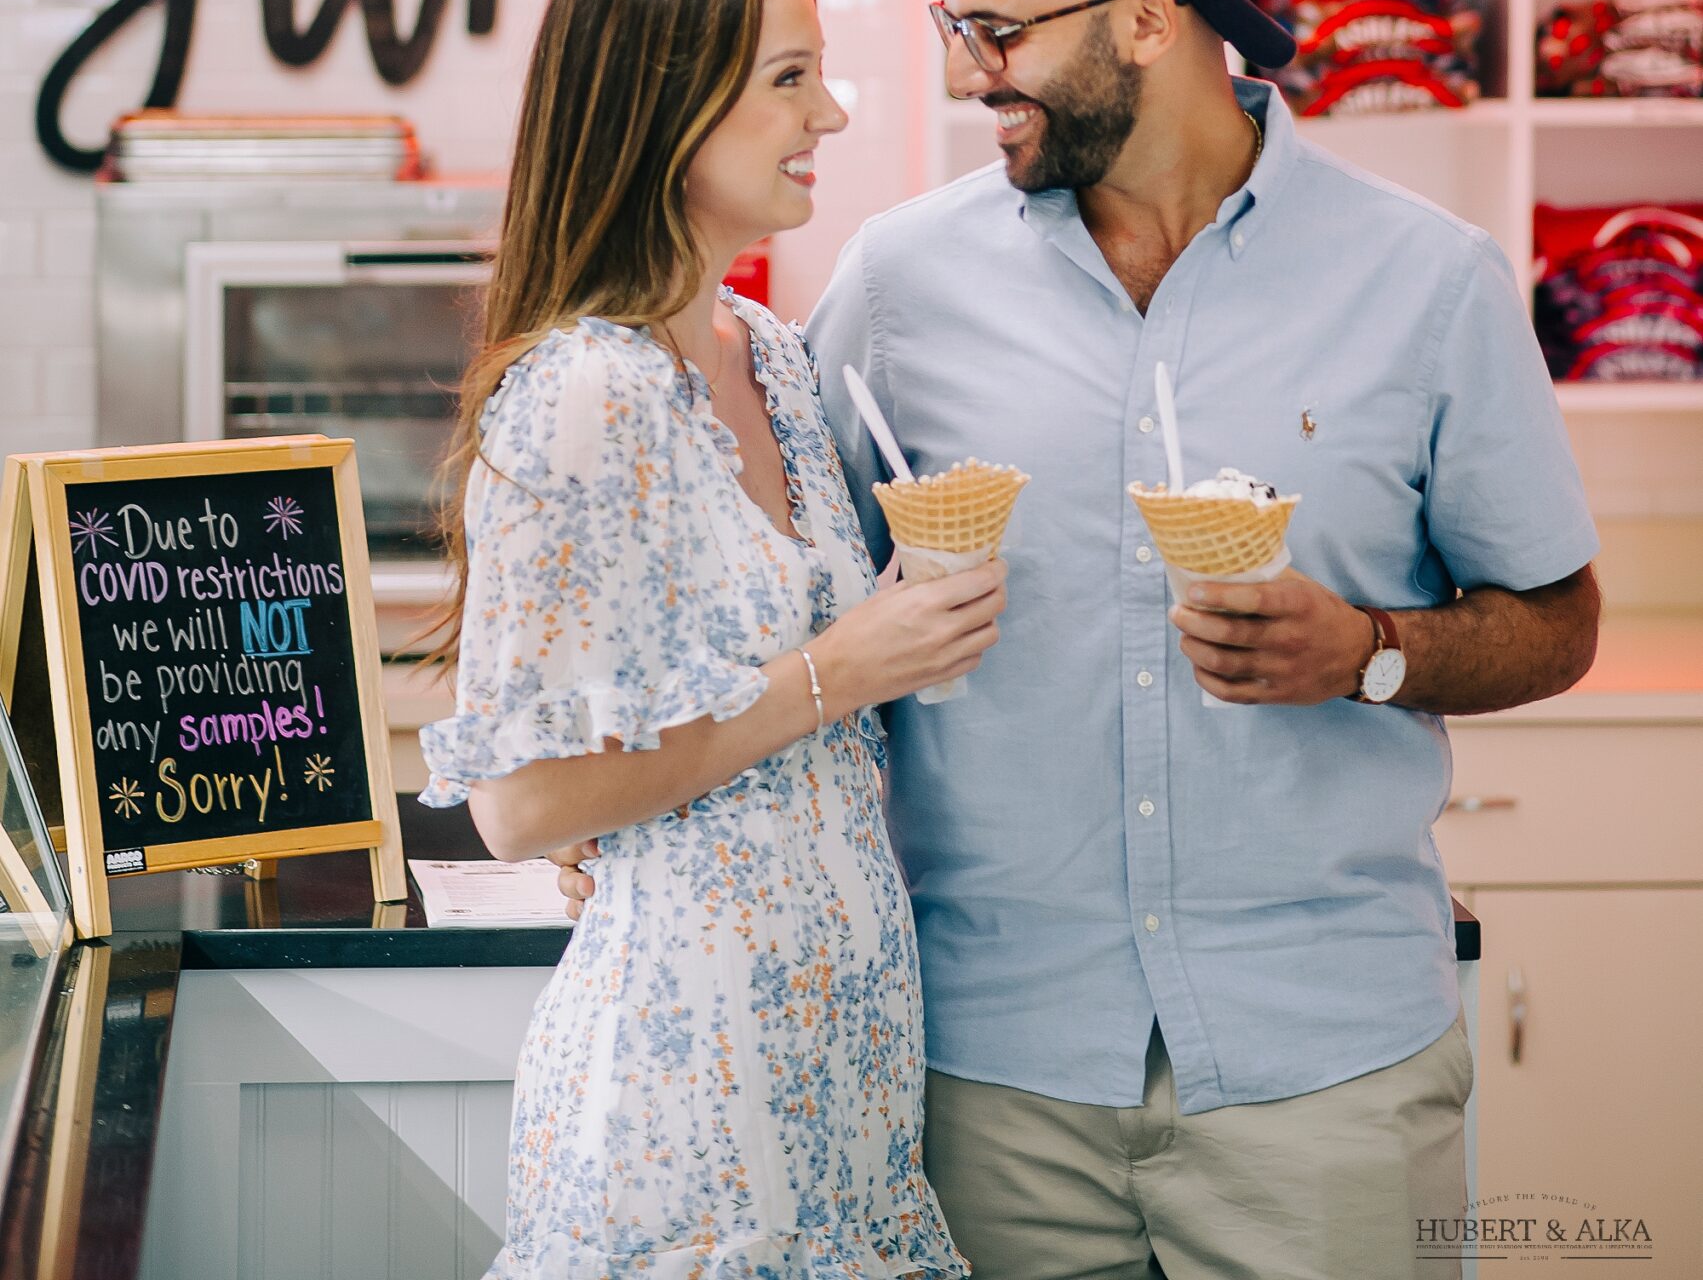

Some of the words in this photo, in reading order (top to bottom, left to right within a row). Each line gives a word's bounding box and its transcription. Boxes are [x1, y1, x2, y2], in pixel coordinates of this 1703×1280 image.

[117, 503, 195, 559] Due
[199, 498, 239, 549] to
[80, 561, 168, 606] COVID
[176, 553, 344, 601] restrictions
[113, 619, 160, 652] we
[167, 607, 229, 651] will
[239, 599, 313, 654] NOT
[100, 659, 142, 703] be
[157, 654, 305, 714] providing
[97, 719, 161, 763] any
[180, 685, 328, 757] samples!
[156, 744, 290, 823] Sorry!
